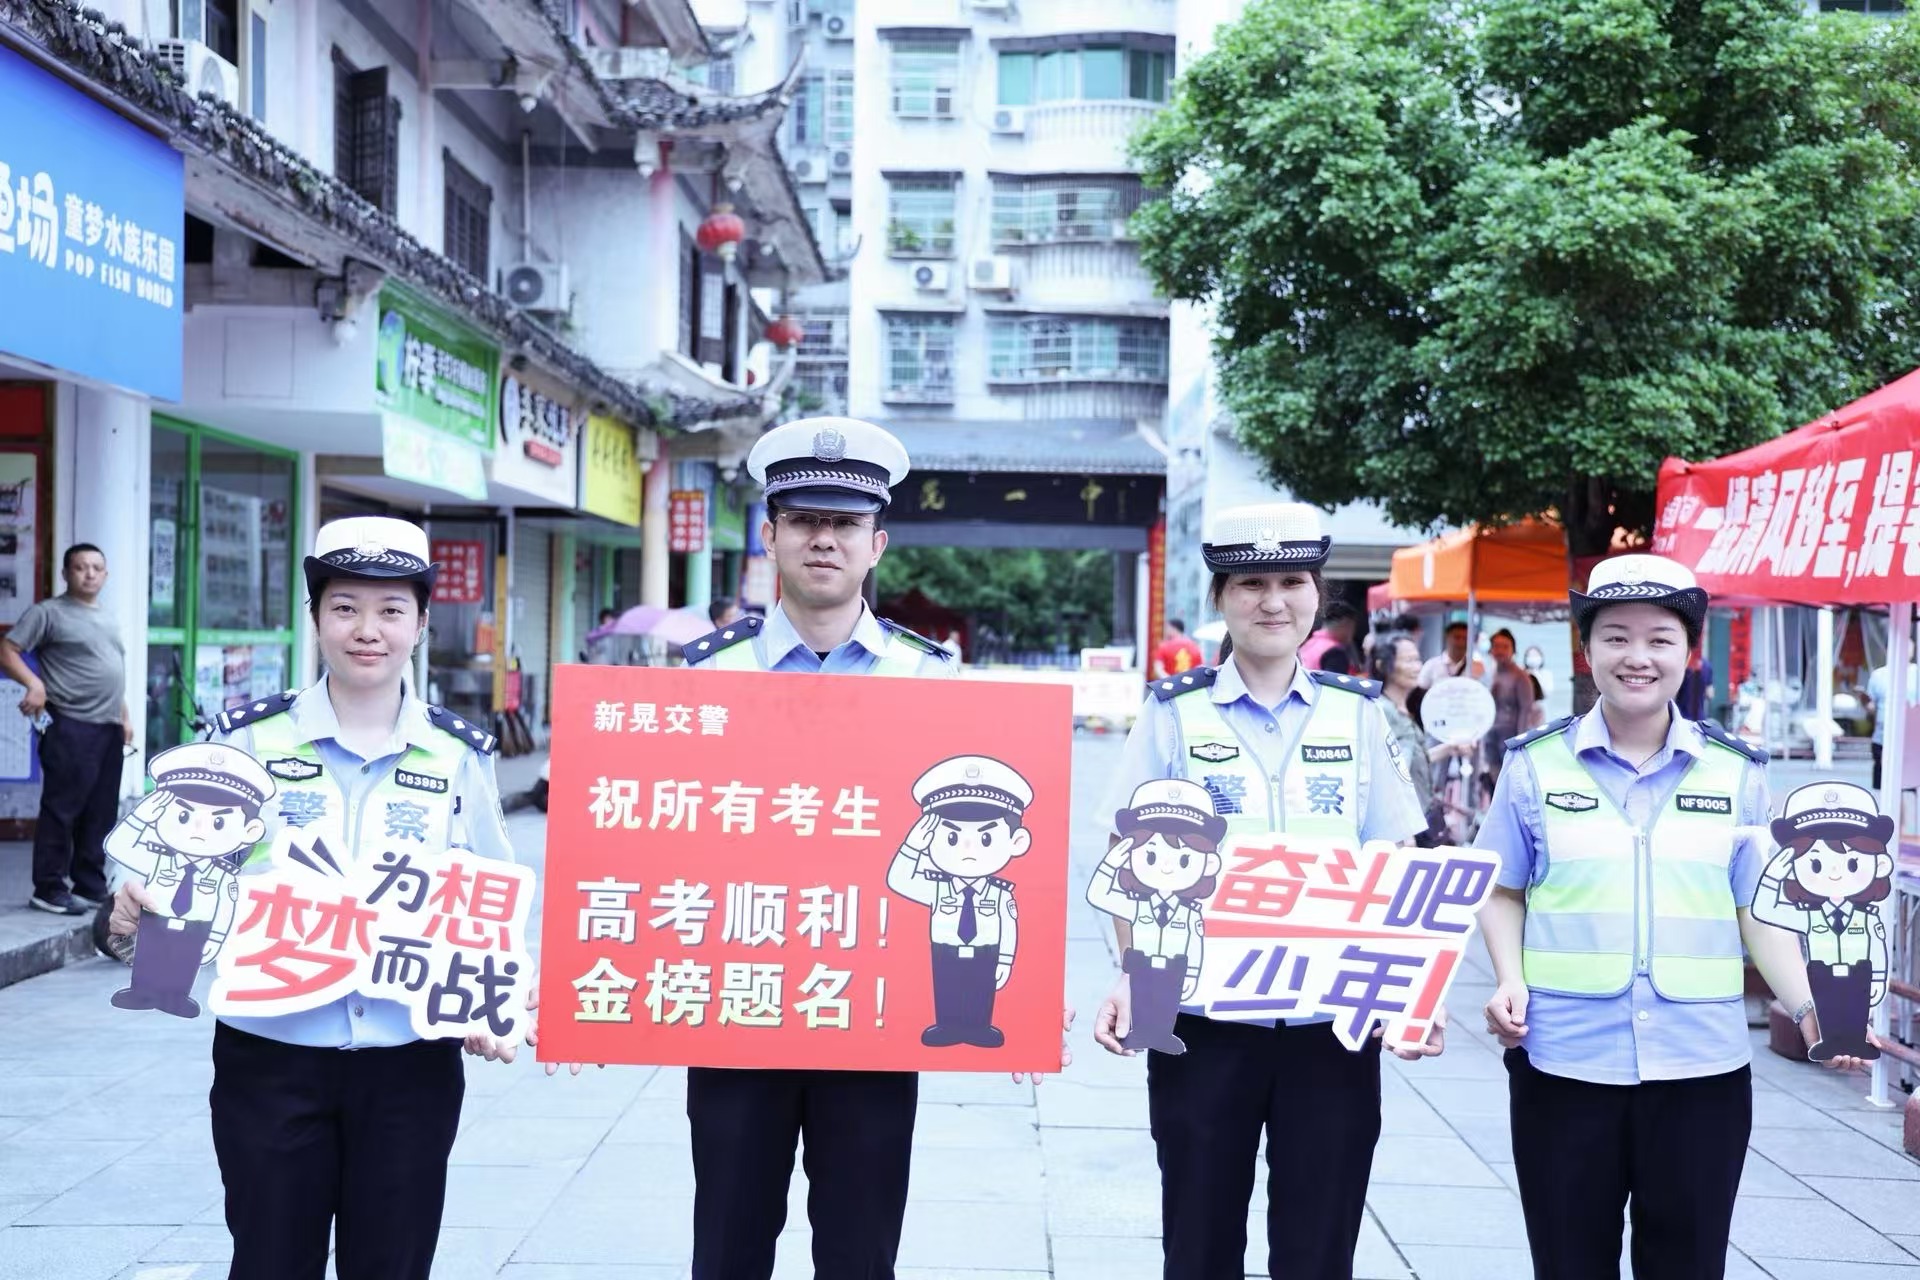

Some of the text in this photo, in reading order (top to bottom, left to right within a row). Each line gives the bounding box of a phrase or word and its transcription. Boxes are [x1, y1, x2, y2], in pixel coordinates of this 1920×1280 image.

[64, 193, 175, 282] 童梦水族乐园
[65, 249, 174, 309] POP FISH WORLD
[594, 701, 729, 736] 新晃交警
[1305, 748, 1350, 760] XJ0840
[589, 776, 881, 837] 祝所有考生
[1680, 797, 1728, 811] NF9005
[576, 876, 888, 950] 高考顺利！
[1211, 844, 1497, 933] 奋斗吧
[225, 884, 379, 1001] 梦
[572, 957, 887, 1031] 金榜题名！
[1209, 945, 1459, 1042] 少年！
